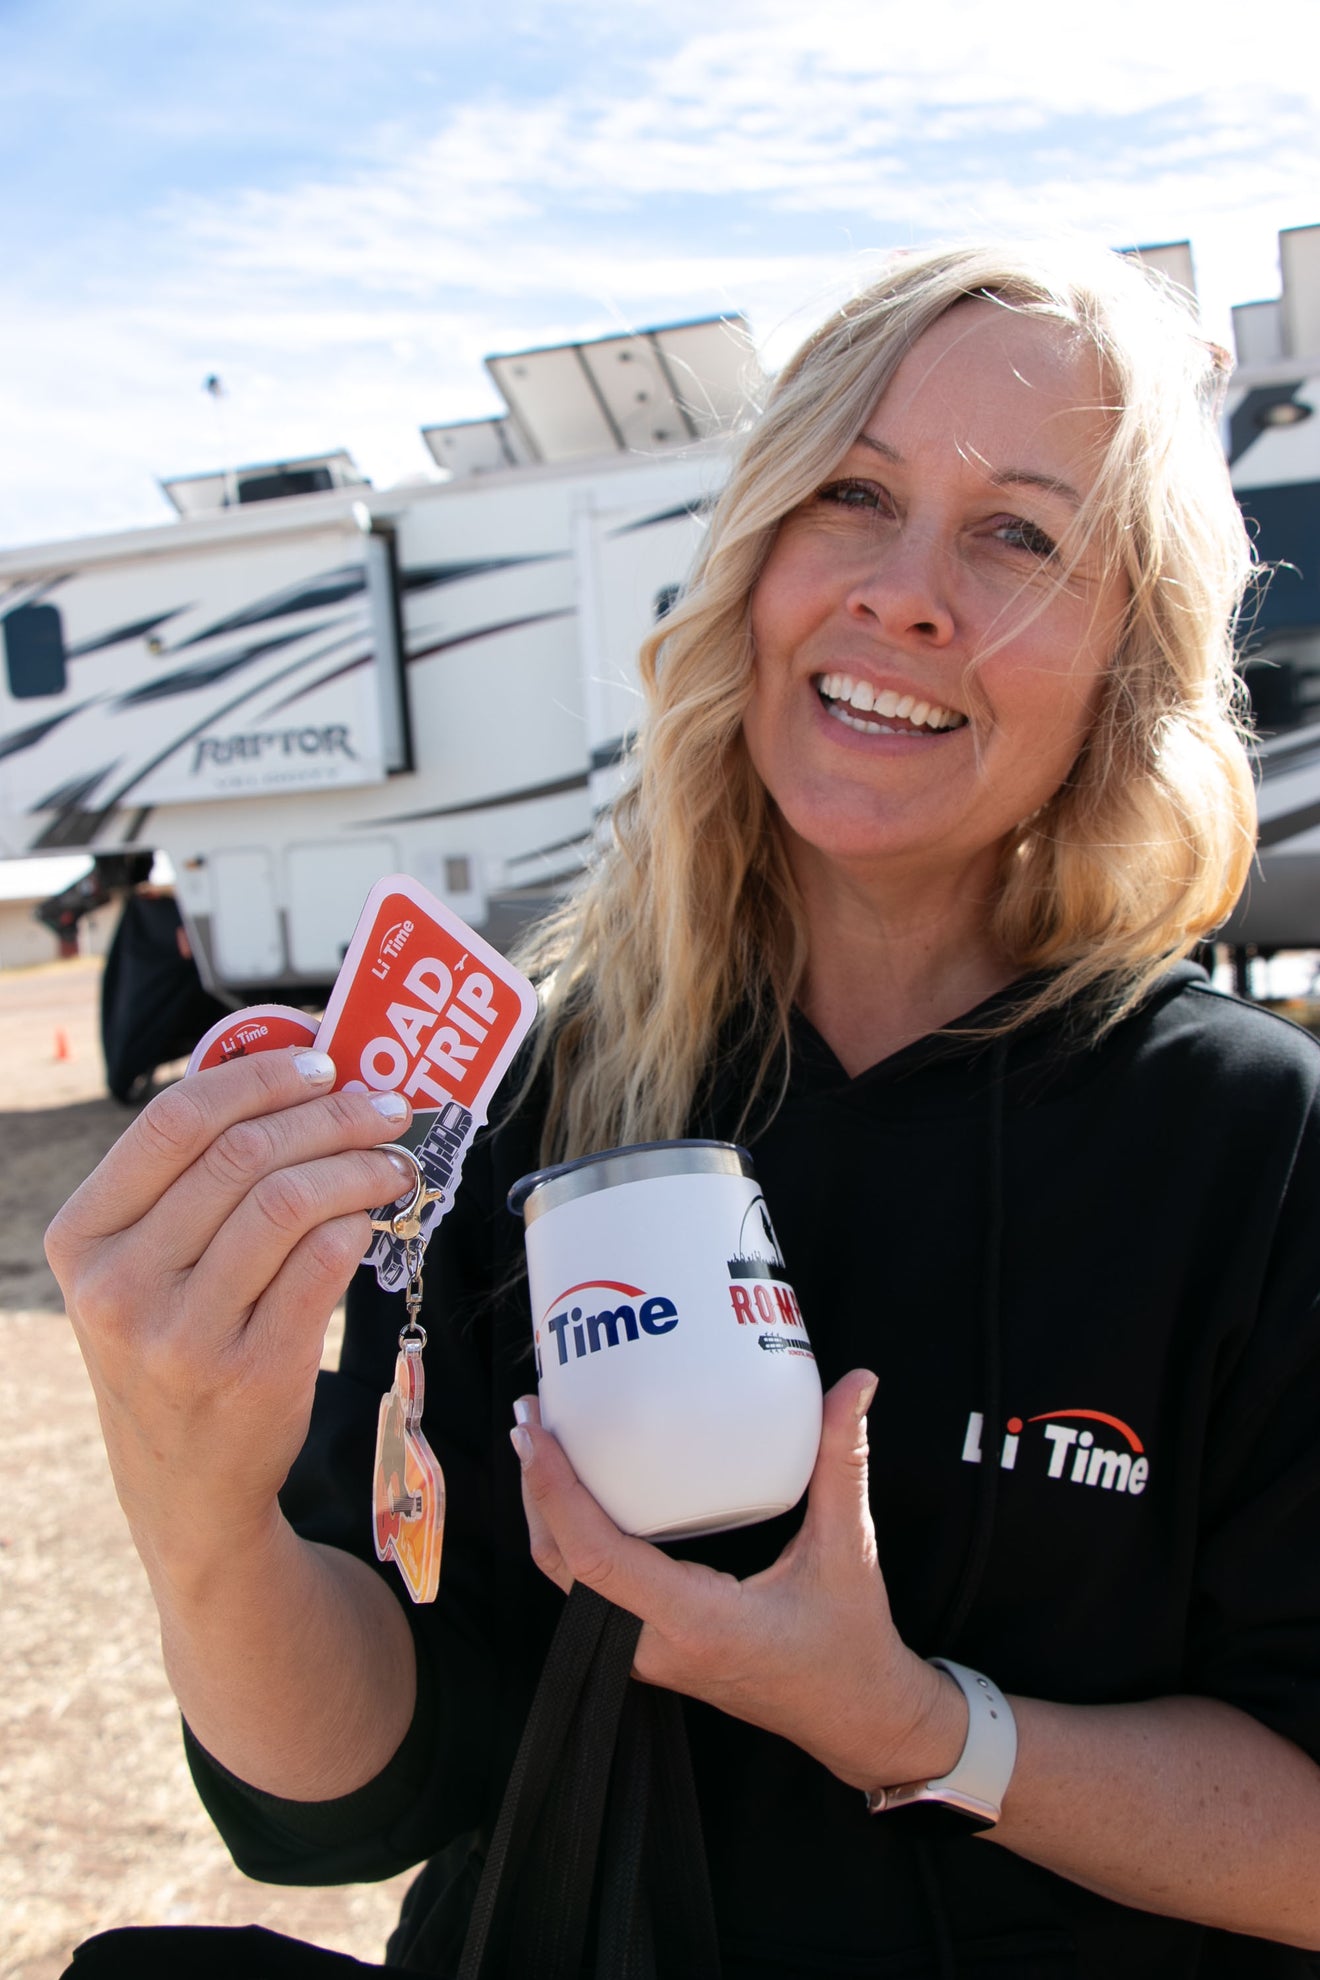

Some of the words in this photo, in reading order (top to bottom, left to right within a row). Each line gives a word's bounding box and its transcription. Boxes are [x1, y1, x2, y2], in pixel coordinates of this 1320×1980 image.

[371, 958, 391, 980] Li
[383, 920, 415, 958] Time
[221, 1037, 236, 1053] Li
[236, 1025, 269, 1046] Time
[341, 957, 453, 1092] OAD
[403, 972, 499, 1106] TRIP
[548, 1296, 679, 1366] Time
[961, 1411, 1024, 1470] Li
[1044, 1423, 1149, 1495] Time
